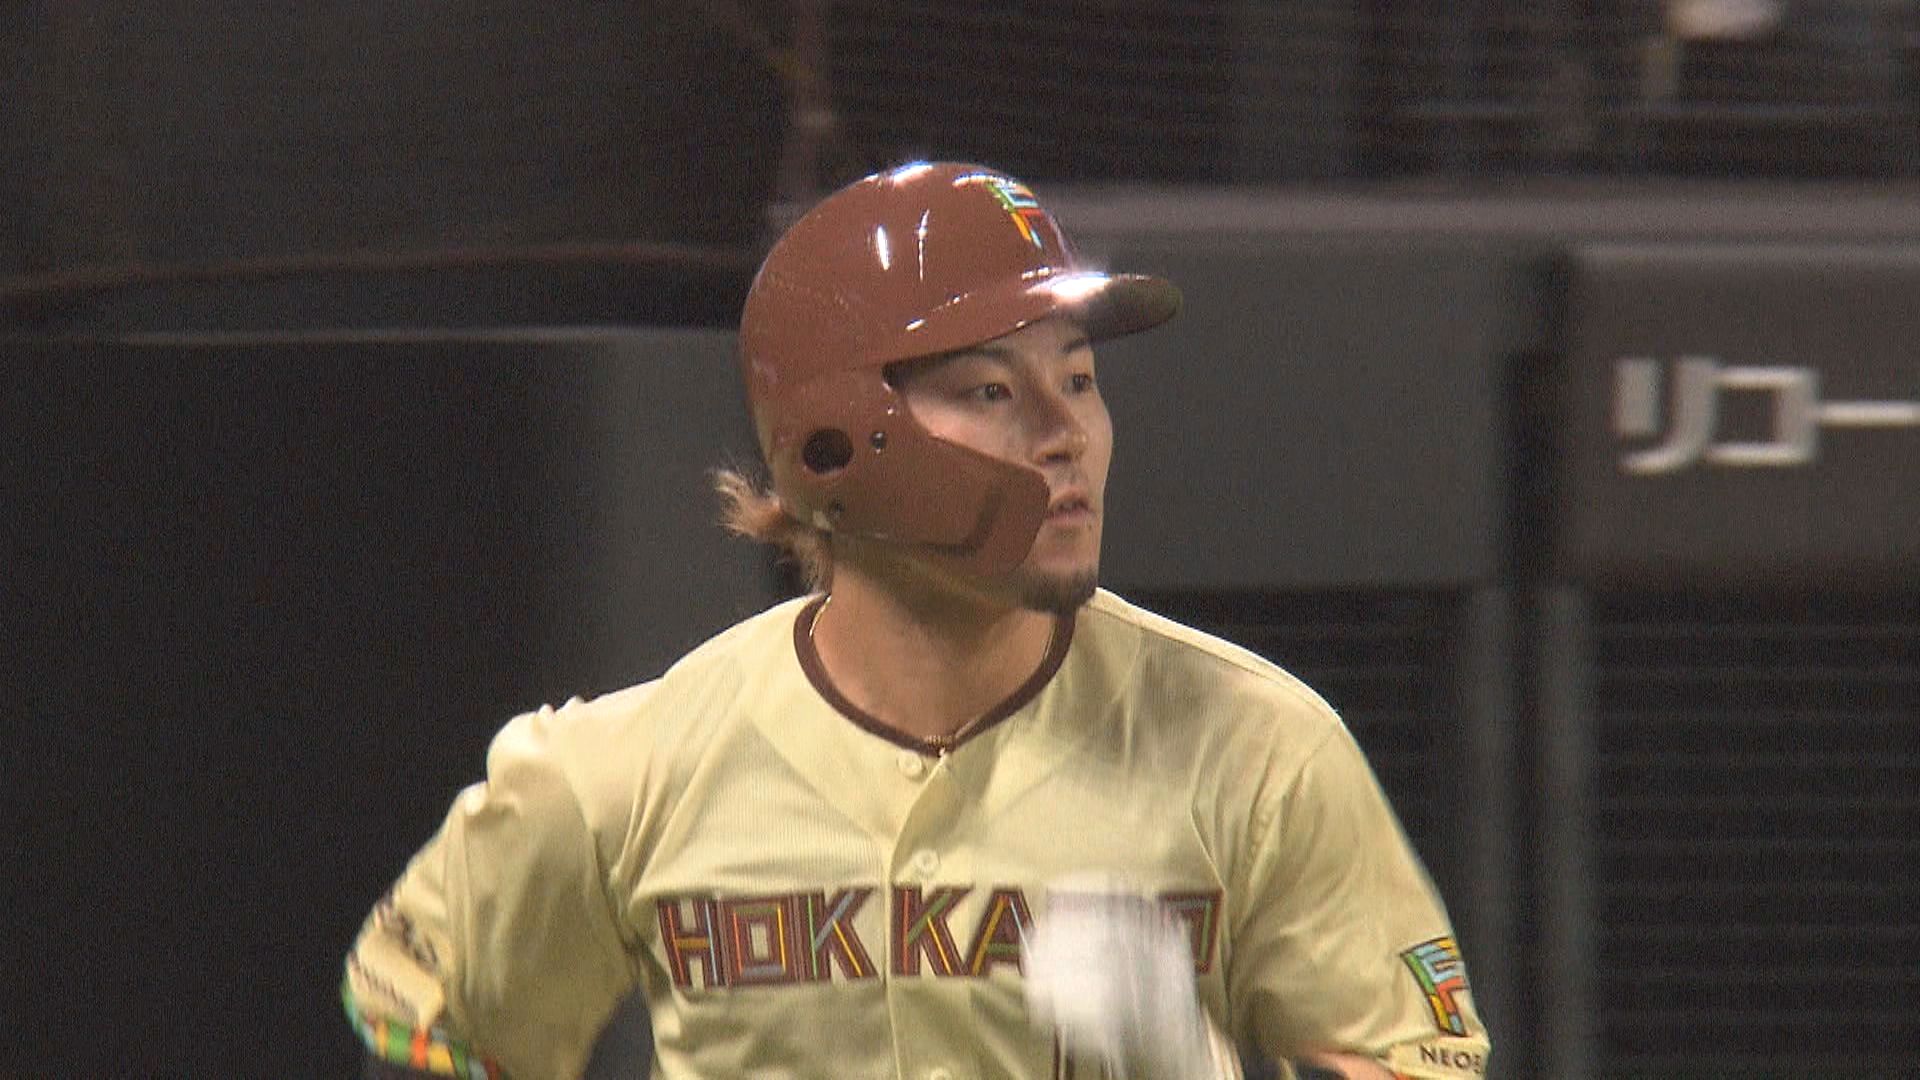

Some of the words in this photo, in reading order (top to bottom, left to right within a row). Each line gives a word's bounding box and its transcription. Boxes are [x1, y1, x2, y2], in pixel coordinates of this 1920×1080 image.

[1611, 357, 1920, 474] リコー
[656, 884, 1225, 990] HOKKA
